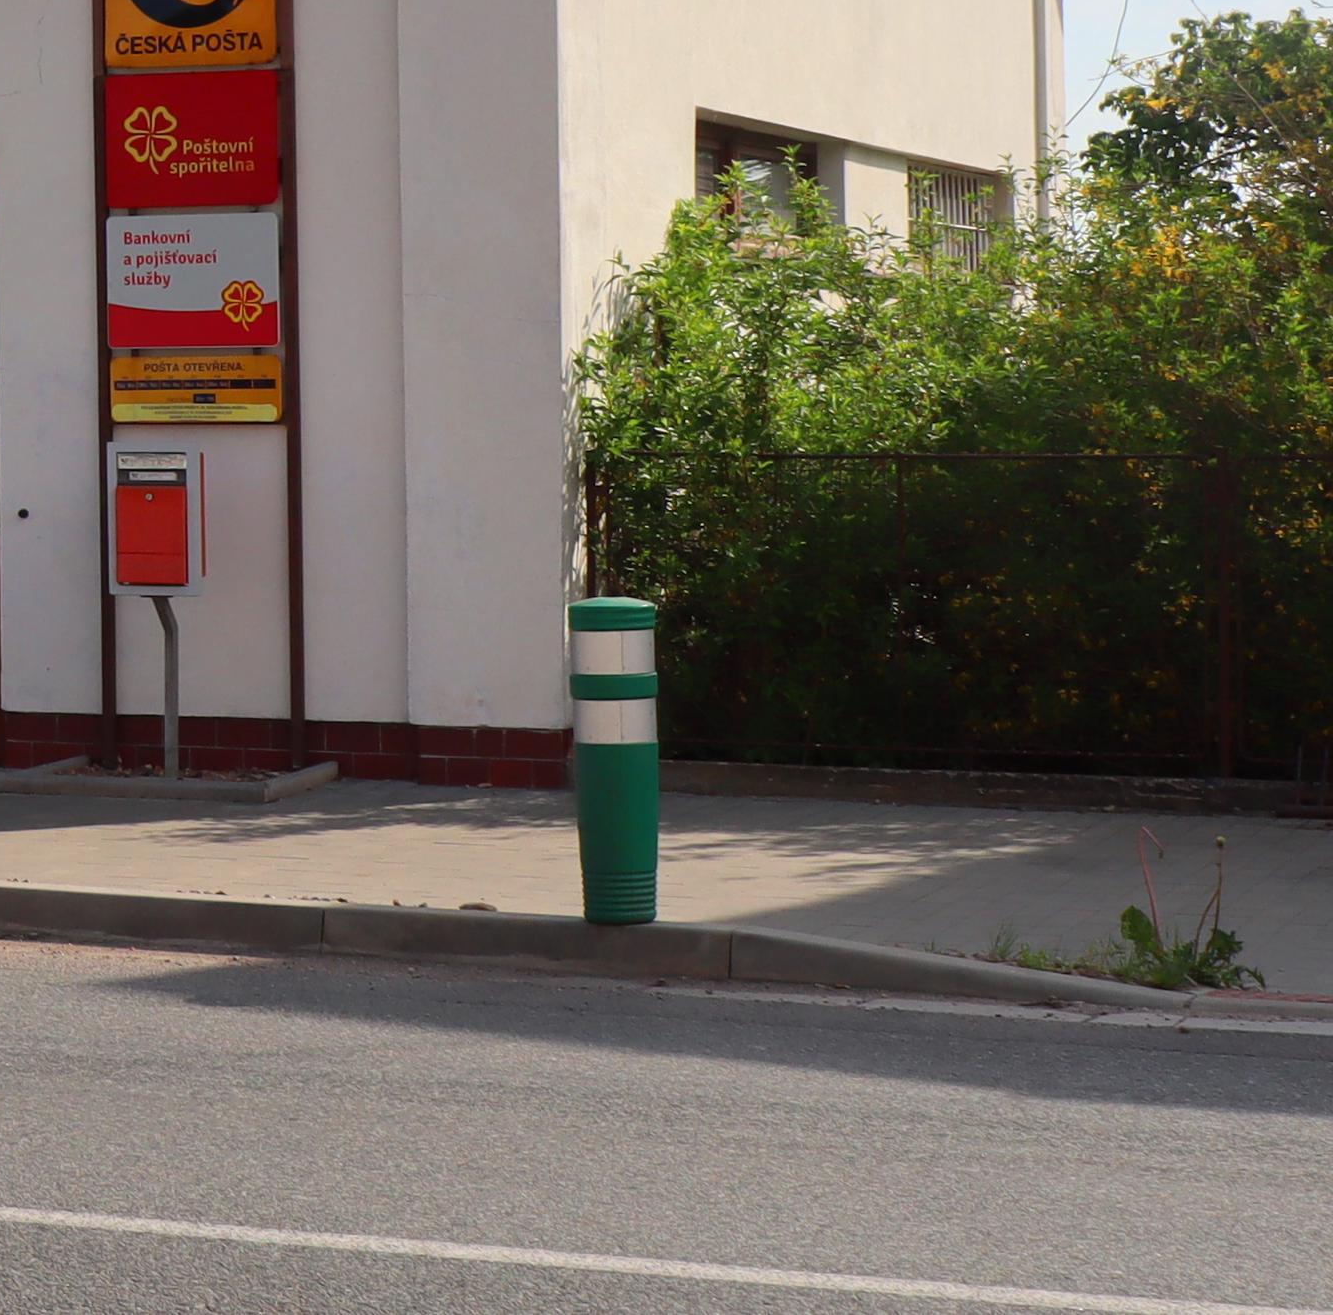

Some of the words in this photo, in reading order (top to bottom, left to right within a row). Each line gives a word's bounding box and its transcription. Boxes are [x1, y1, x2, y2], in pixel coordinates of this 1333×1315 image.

[115, 32, 186, 54] ČESKÁ
[192, 29, 263, 52] POŠTA
[183, 136, 253, 155] Poštovní
[170, 156, 255, 178] spořitelna
[123, 229, 191, 245] Bankovní
[123, 255, 132, 265] a
[136, 249, 217, 268] pojišťovací
[123, 271, 171, 288] služby
[143, 361, 180, 372] POŠTA
